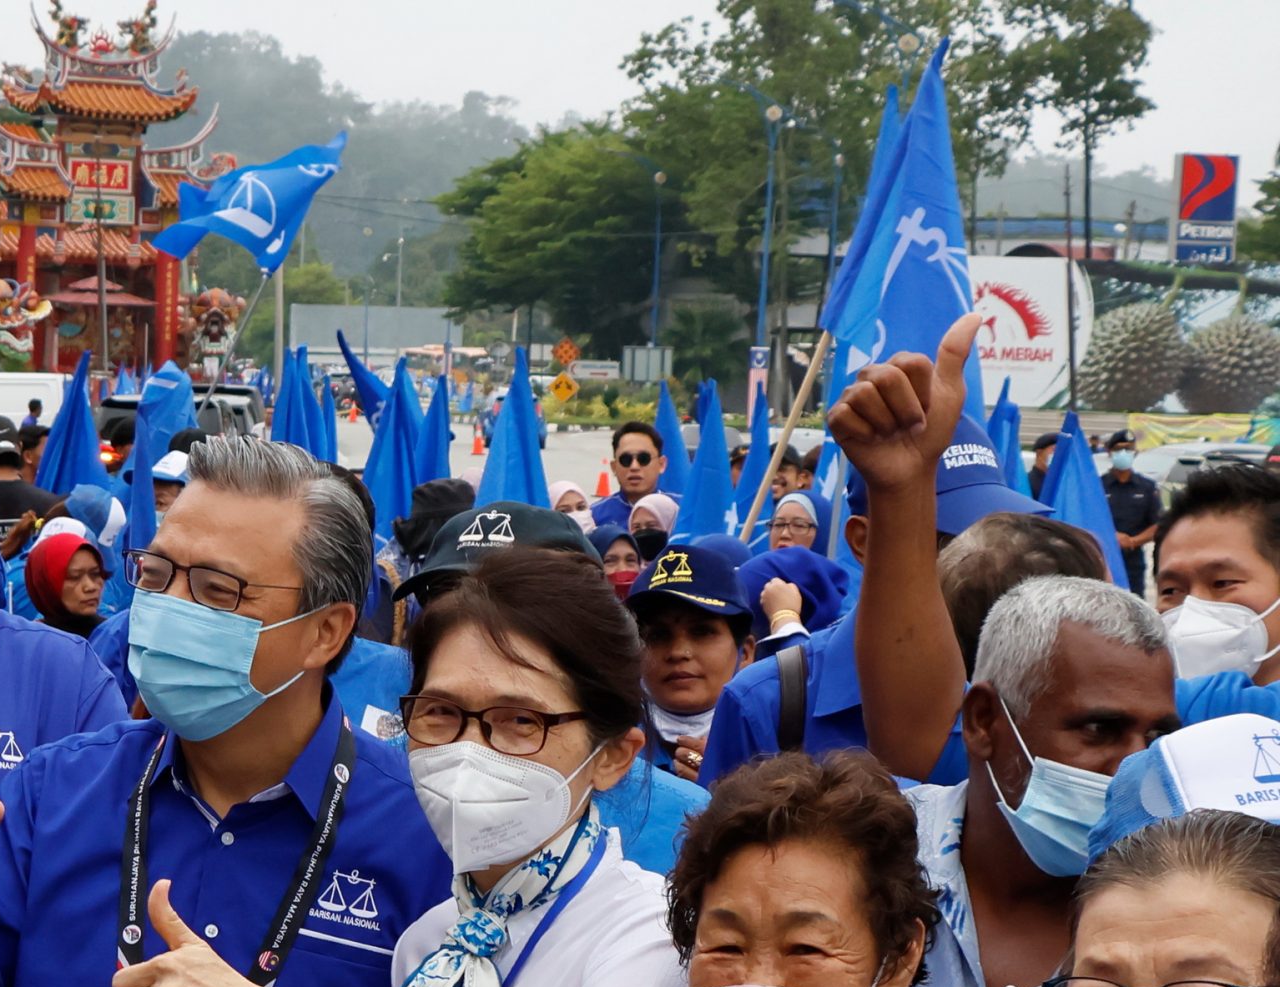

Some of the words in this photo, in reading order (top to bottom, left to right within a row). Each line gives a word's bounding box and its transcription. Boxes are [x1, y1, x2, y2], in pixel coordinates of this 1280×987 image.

[1180, 222, 1233, 238] PETRON
[1001, 346, 1053, 361] MERAH
[944, 454, 998, 470] MALAYSIA
[135, 794, 143, 818] RAYA
[1235, 788, 1280, 806] BARIS
[318, 783, 343, 844] SURUHANJAYA
[133, 818, 141, 856] PILIHAN
[304, 844, 322, 881] PILIHAN
[128, 855, 141, 922] SURUHANJAYA
[293, 880, 308, 902] RAYA
[272, 903, 298, 949] MALAYSIA
[308, 907, 342, 923] BARISAN
[343, 915, 381, 931] NASIONAL
